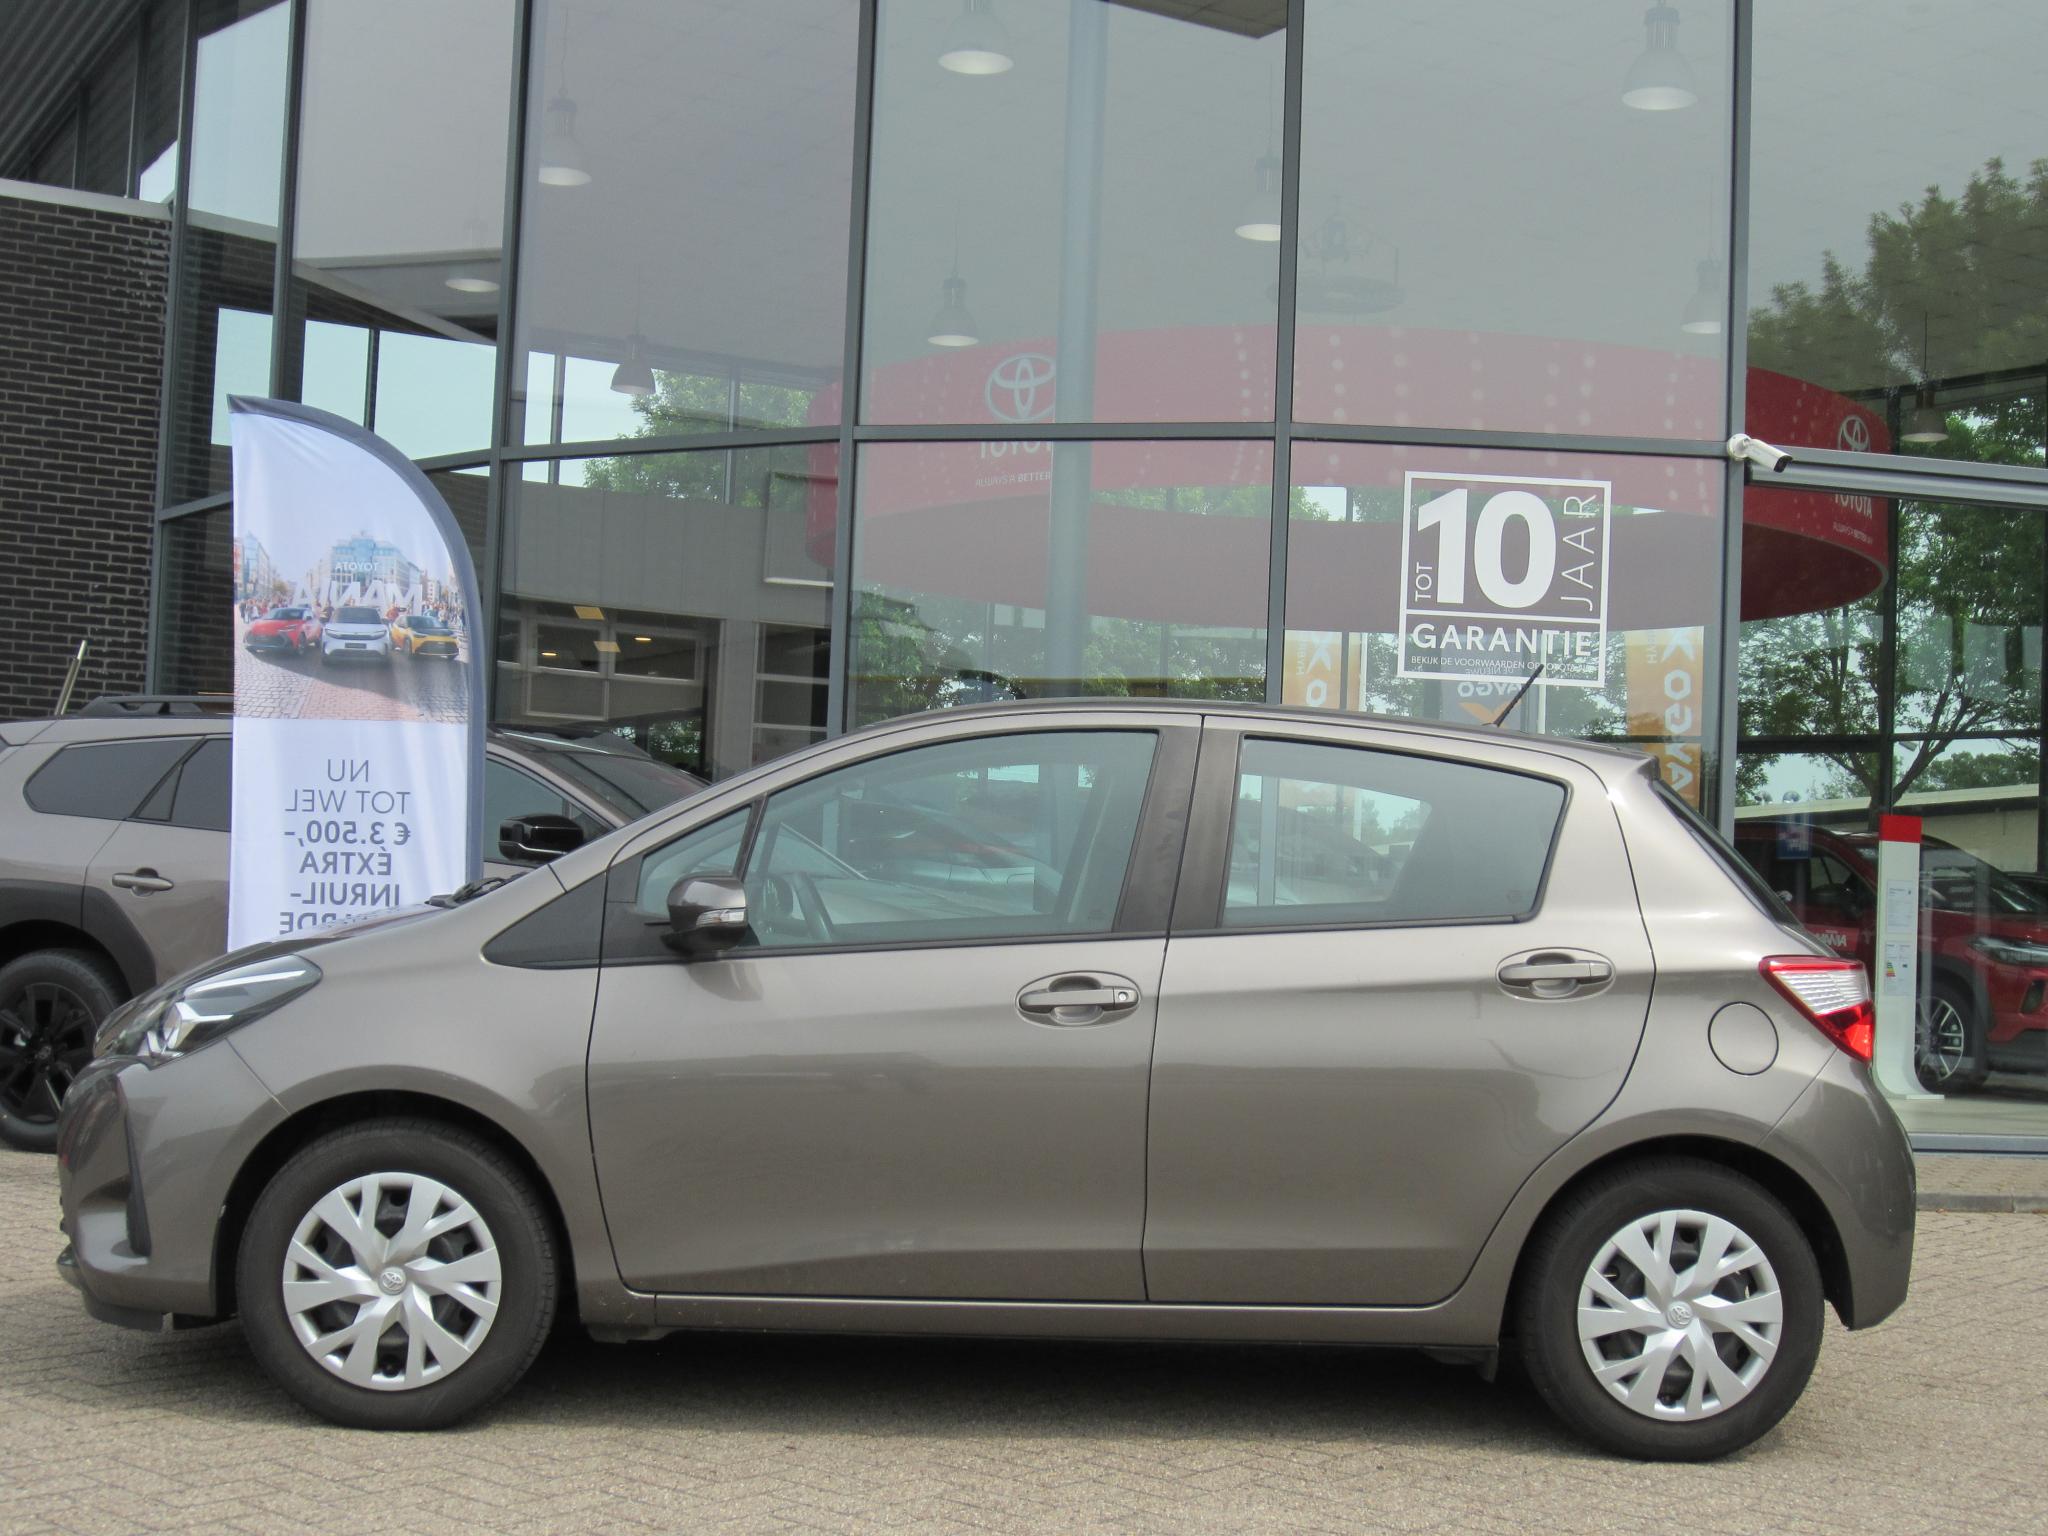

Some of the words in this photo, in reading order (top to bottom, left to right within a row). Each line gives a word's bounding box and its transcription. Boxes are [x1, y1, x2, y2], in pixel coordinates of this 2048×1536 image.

[1417, 488, 1557, 609] 10
[1560, 494, 1597, 612] JAAR
[1414, 561, 1433, 603] TOT
[1412, 623, 1593, 657] GARANTIE
[1411, 656, 1439, 665] BEKIJK
[1440, 657, 1453, 666] DE
[1453, 658, 1525, 670] VOORWAARDEN
